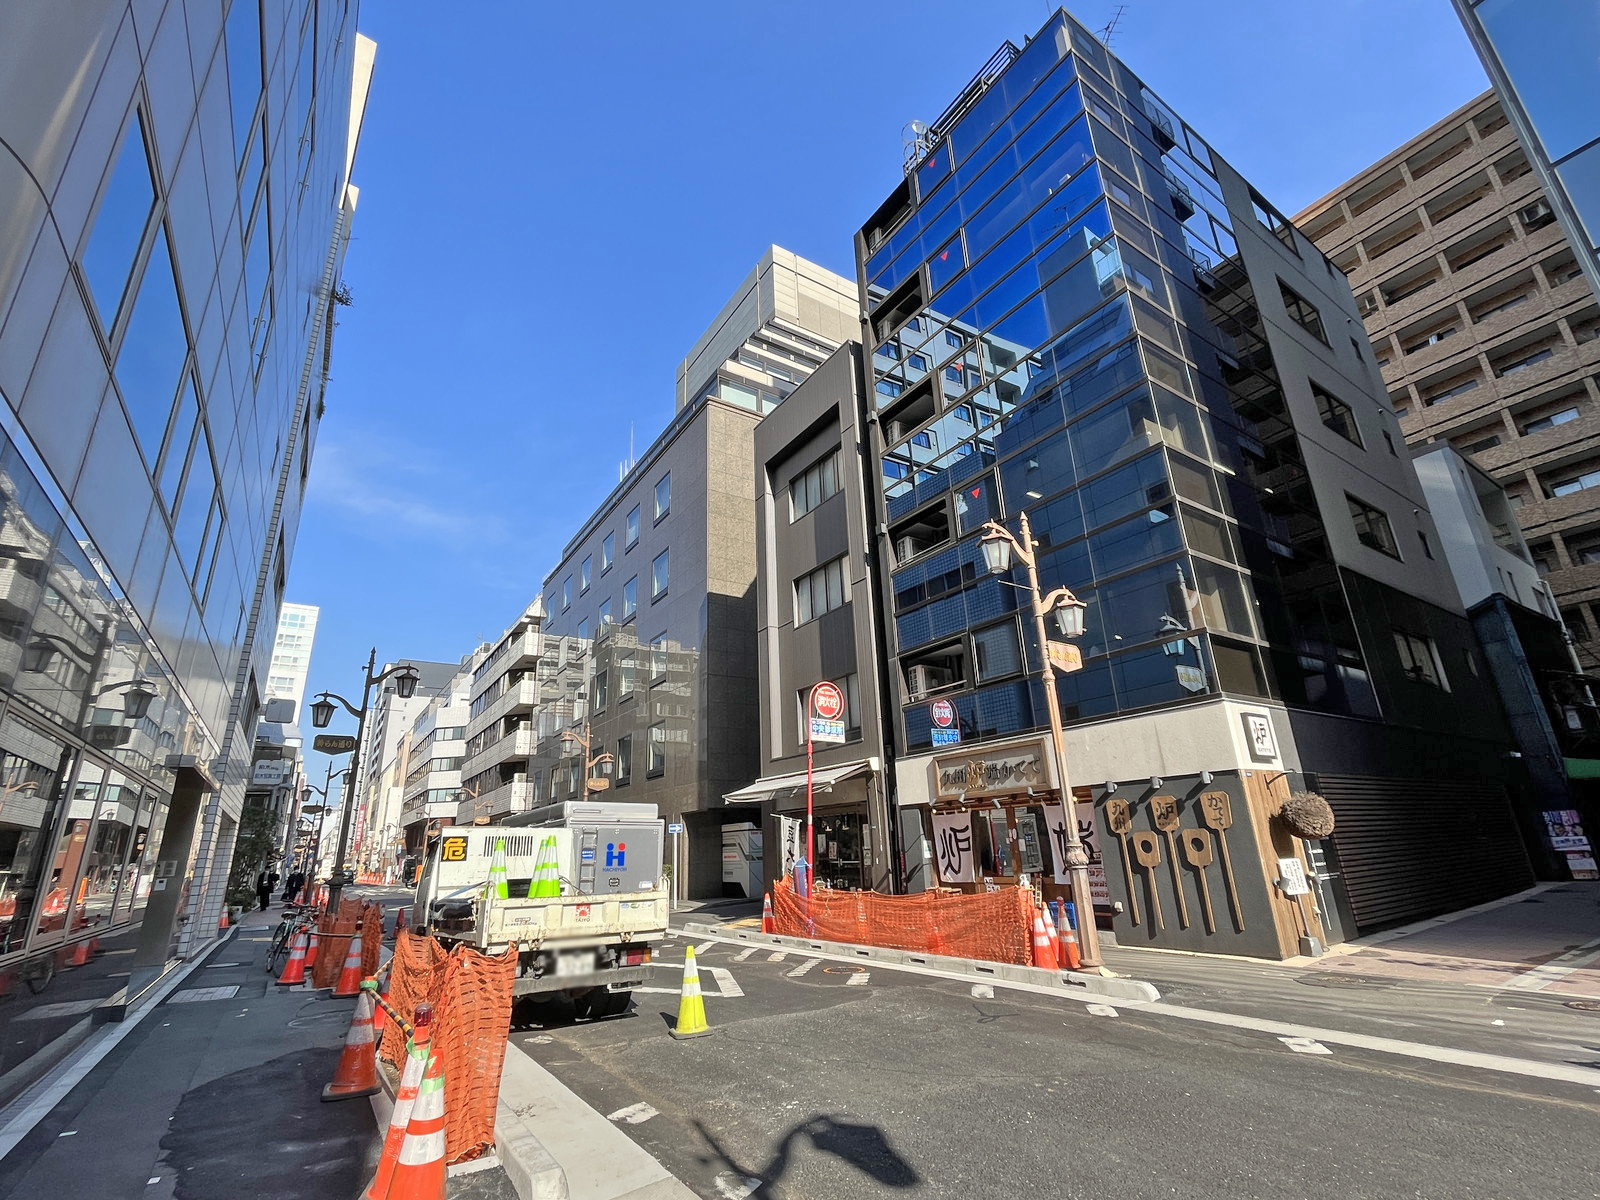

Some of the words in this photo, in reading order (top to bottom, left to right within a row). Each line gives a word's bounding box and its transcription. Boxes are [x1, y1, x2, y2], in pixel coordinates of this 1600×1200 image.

[817, 695, 838, 709] 消火栓
[1111, 802, 1126, 831] 九州
[1156, 802, 1175, 821] 炉
[1207, 794, 1225, 826] かてて
[443, 836, 468, 861] 危
[939, 824, 971, 876] 炉
